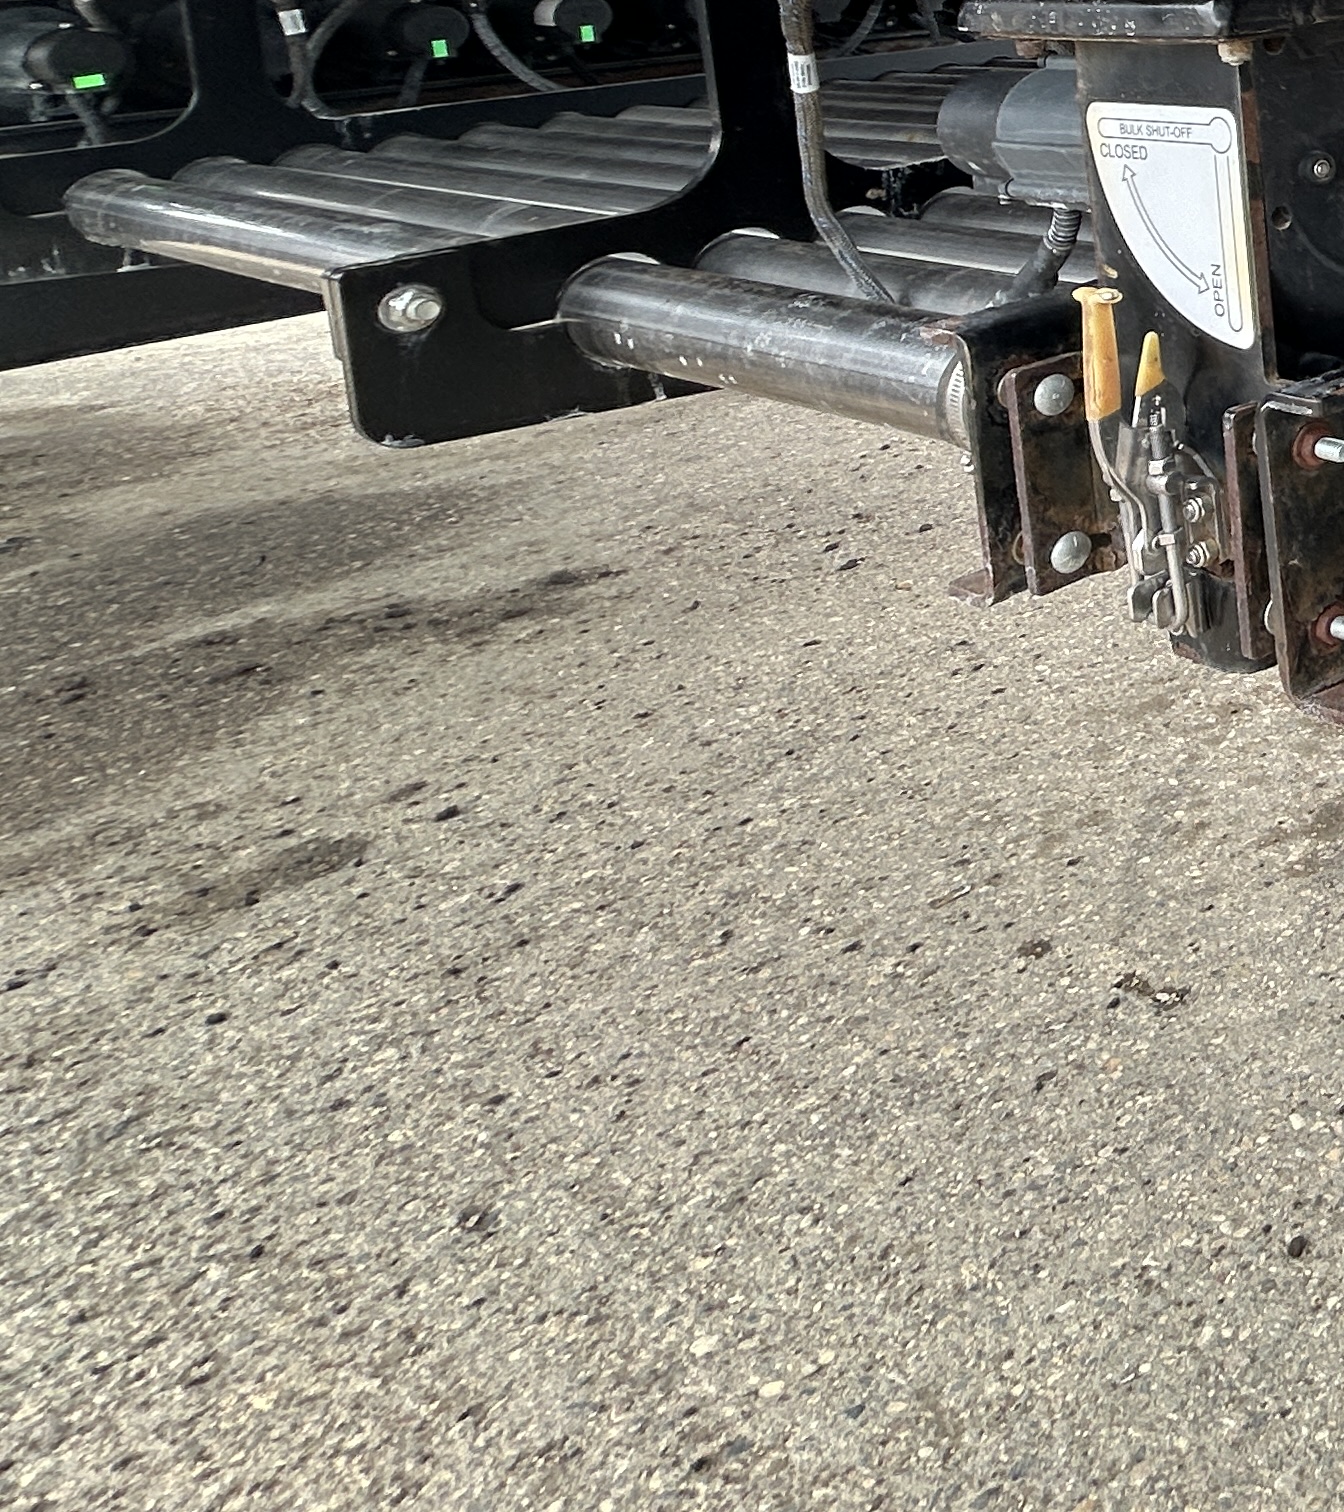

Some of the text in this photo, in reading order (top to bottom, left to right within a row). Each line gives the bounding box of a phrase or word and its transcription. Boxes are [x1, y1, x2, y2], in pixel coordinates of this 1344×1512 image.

[1119, 122, 1192, 139] BULK SHUT-OFF
[1099, 143, 1148, 161] CLOSED
[1210, 263, 1226, 317] OPEN
